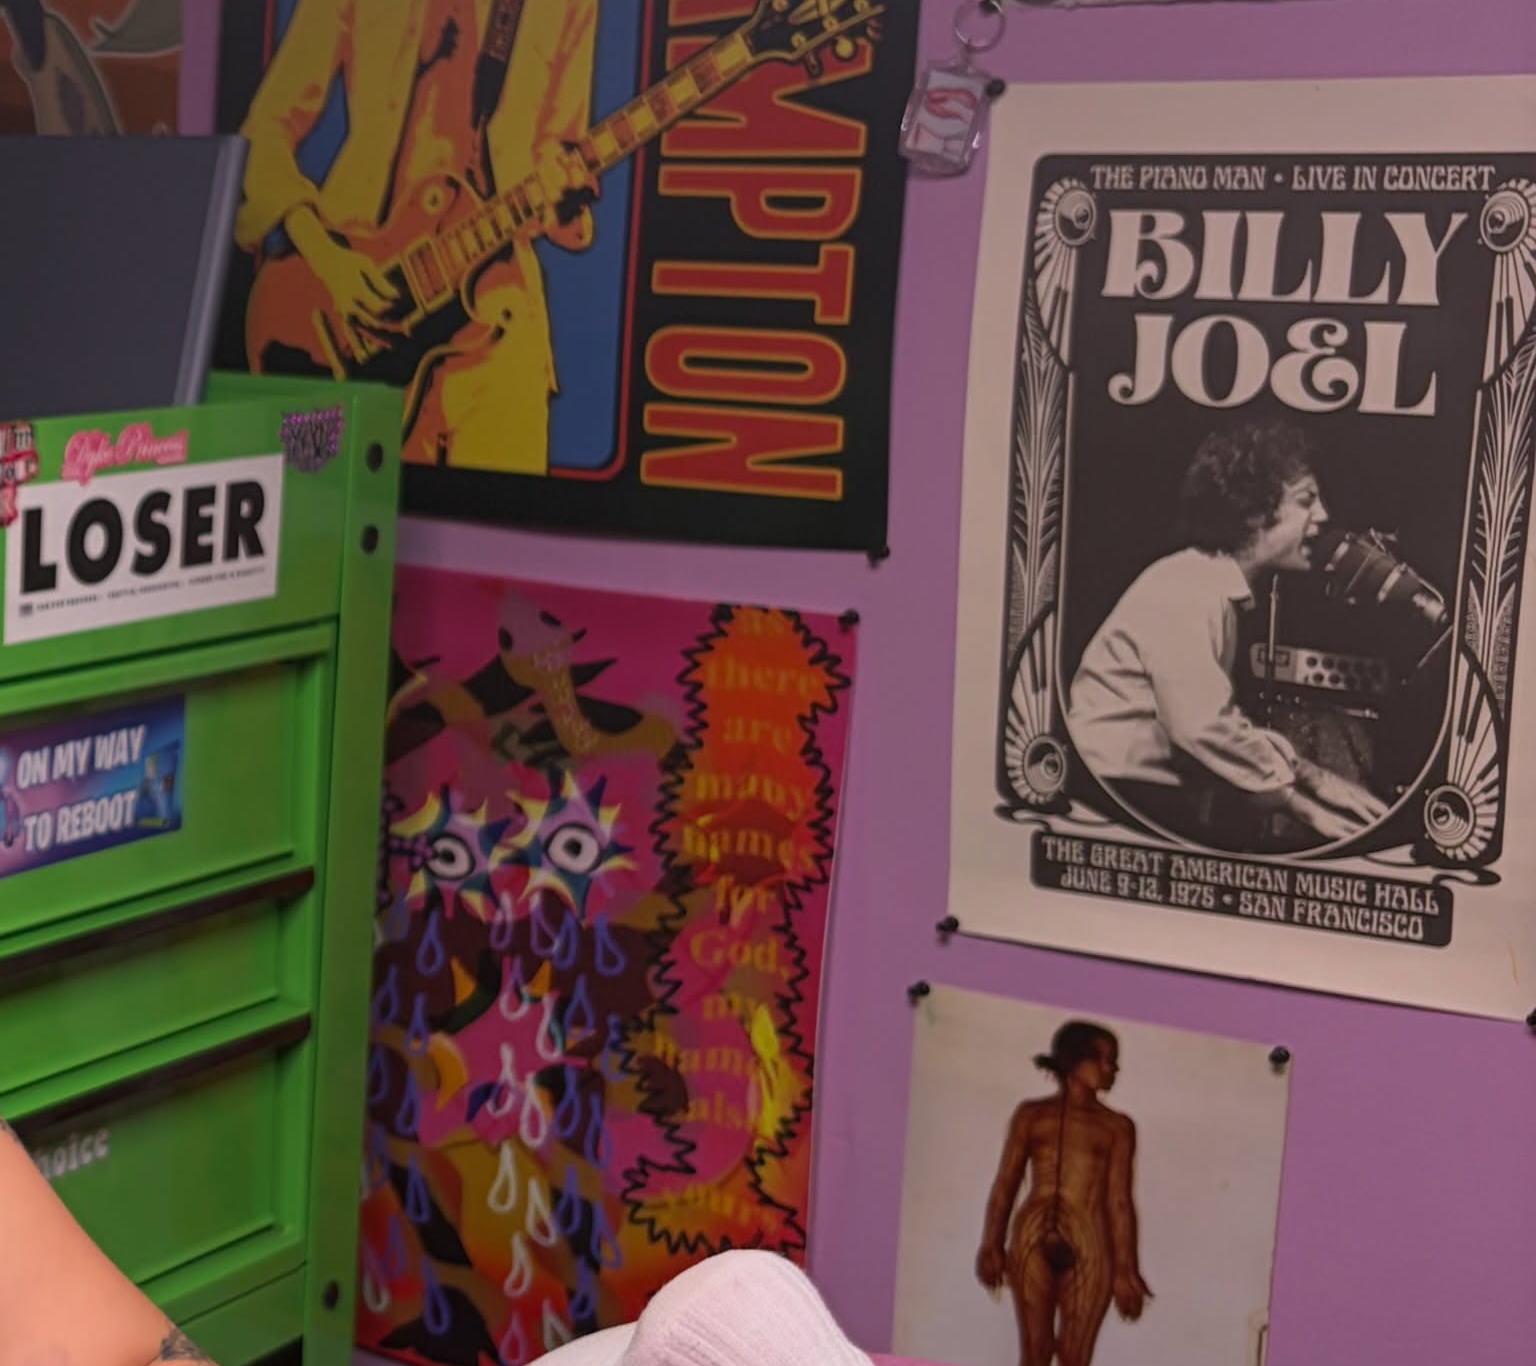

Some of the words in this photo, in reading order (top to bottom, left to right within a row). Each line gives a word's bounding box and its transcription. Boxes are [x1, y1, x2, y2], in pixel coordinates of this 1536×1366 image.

[1090, 166, 1134, 190] THE
[1139, 165, 1208, 189] PIANO
[1213, 165, 1266, 189] MAN
[1292, 165, 1347, 191] LIVE
[1352, 166, 1378, 191] IN
[1383, 165, 1496, 192] CONCERT
[1100, 209, 1469, 306] BILLY
[1107, 313, 1437, 417] JOEL
[20, 480, 266, 594] LOSER
[708, 659, 818, 698] there
[17, 746, 48, 788] ON
[52, 737, 91, 781] MY
[94, 724, 146, 770] WAY
[723, 716, 794, 752] are
[24, 810, 52, 852] TO
[57, 791, 137, 846] REBOOT
[696, 774, 808, 822] many
[1042, 837, 1085, 866] THE
[1091, 843, 1164, 875] GREAT
[1170, 854, 1290, 893] AMERICAN
[1296, 874, 1367, 904] MUSIC
[1375, 886, 1440, 916] HALL
[1061, 866, 1113, 891] JUNE
[1170, 882, 1215, 910] 1975
[1239, 892, 1287, 922] SAN
[1293, 900, 1424, 941] FRANCISCO
[690, 939, 790, 981] God,
